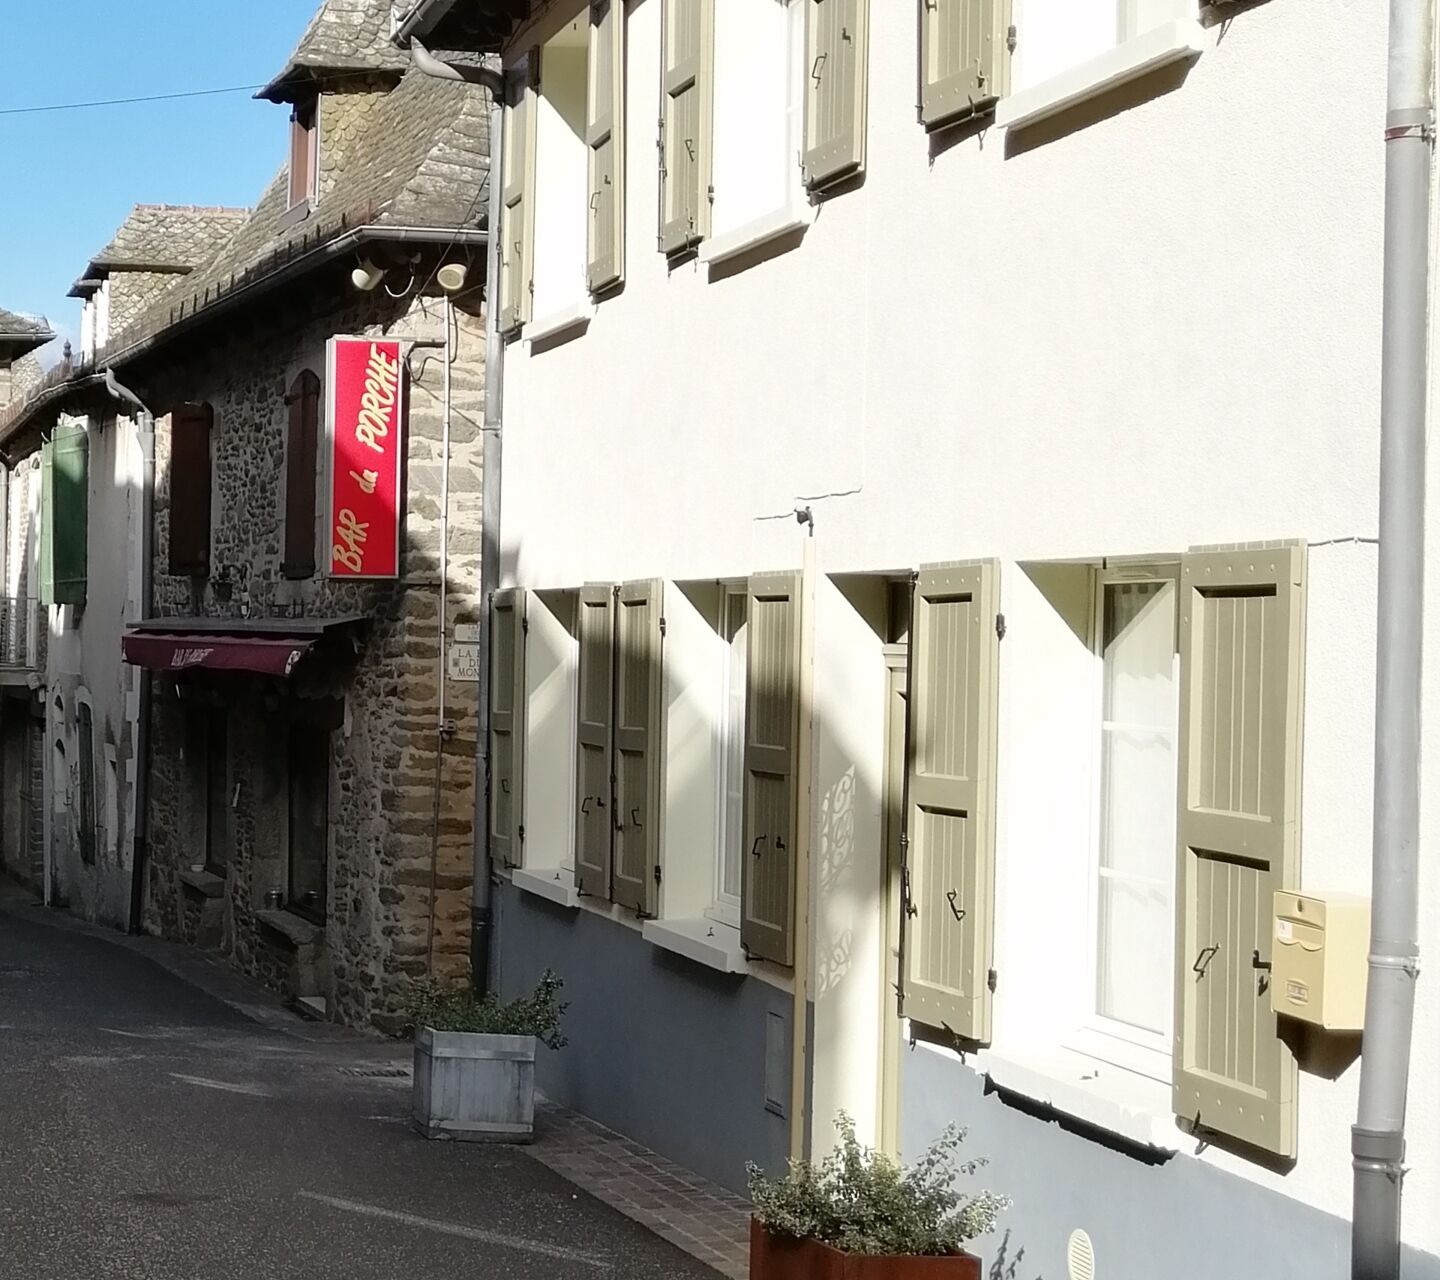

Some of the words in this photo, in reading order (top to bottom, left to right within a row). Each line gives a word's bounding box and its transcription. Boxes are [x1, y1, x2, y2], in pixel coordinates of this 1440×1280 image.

[332, 508, 369, 573] BAR
[356, 343, 398, 453] PORCHE
[458, 649, 472, 658] LA
